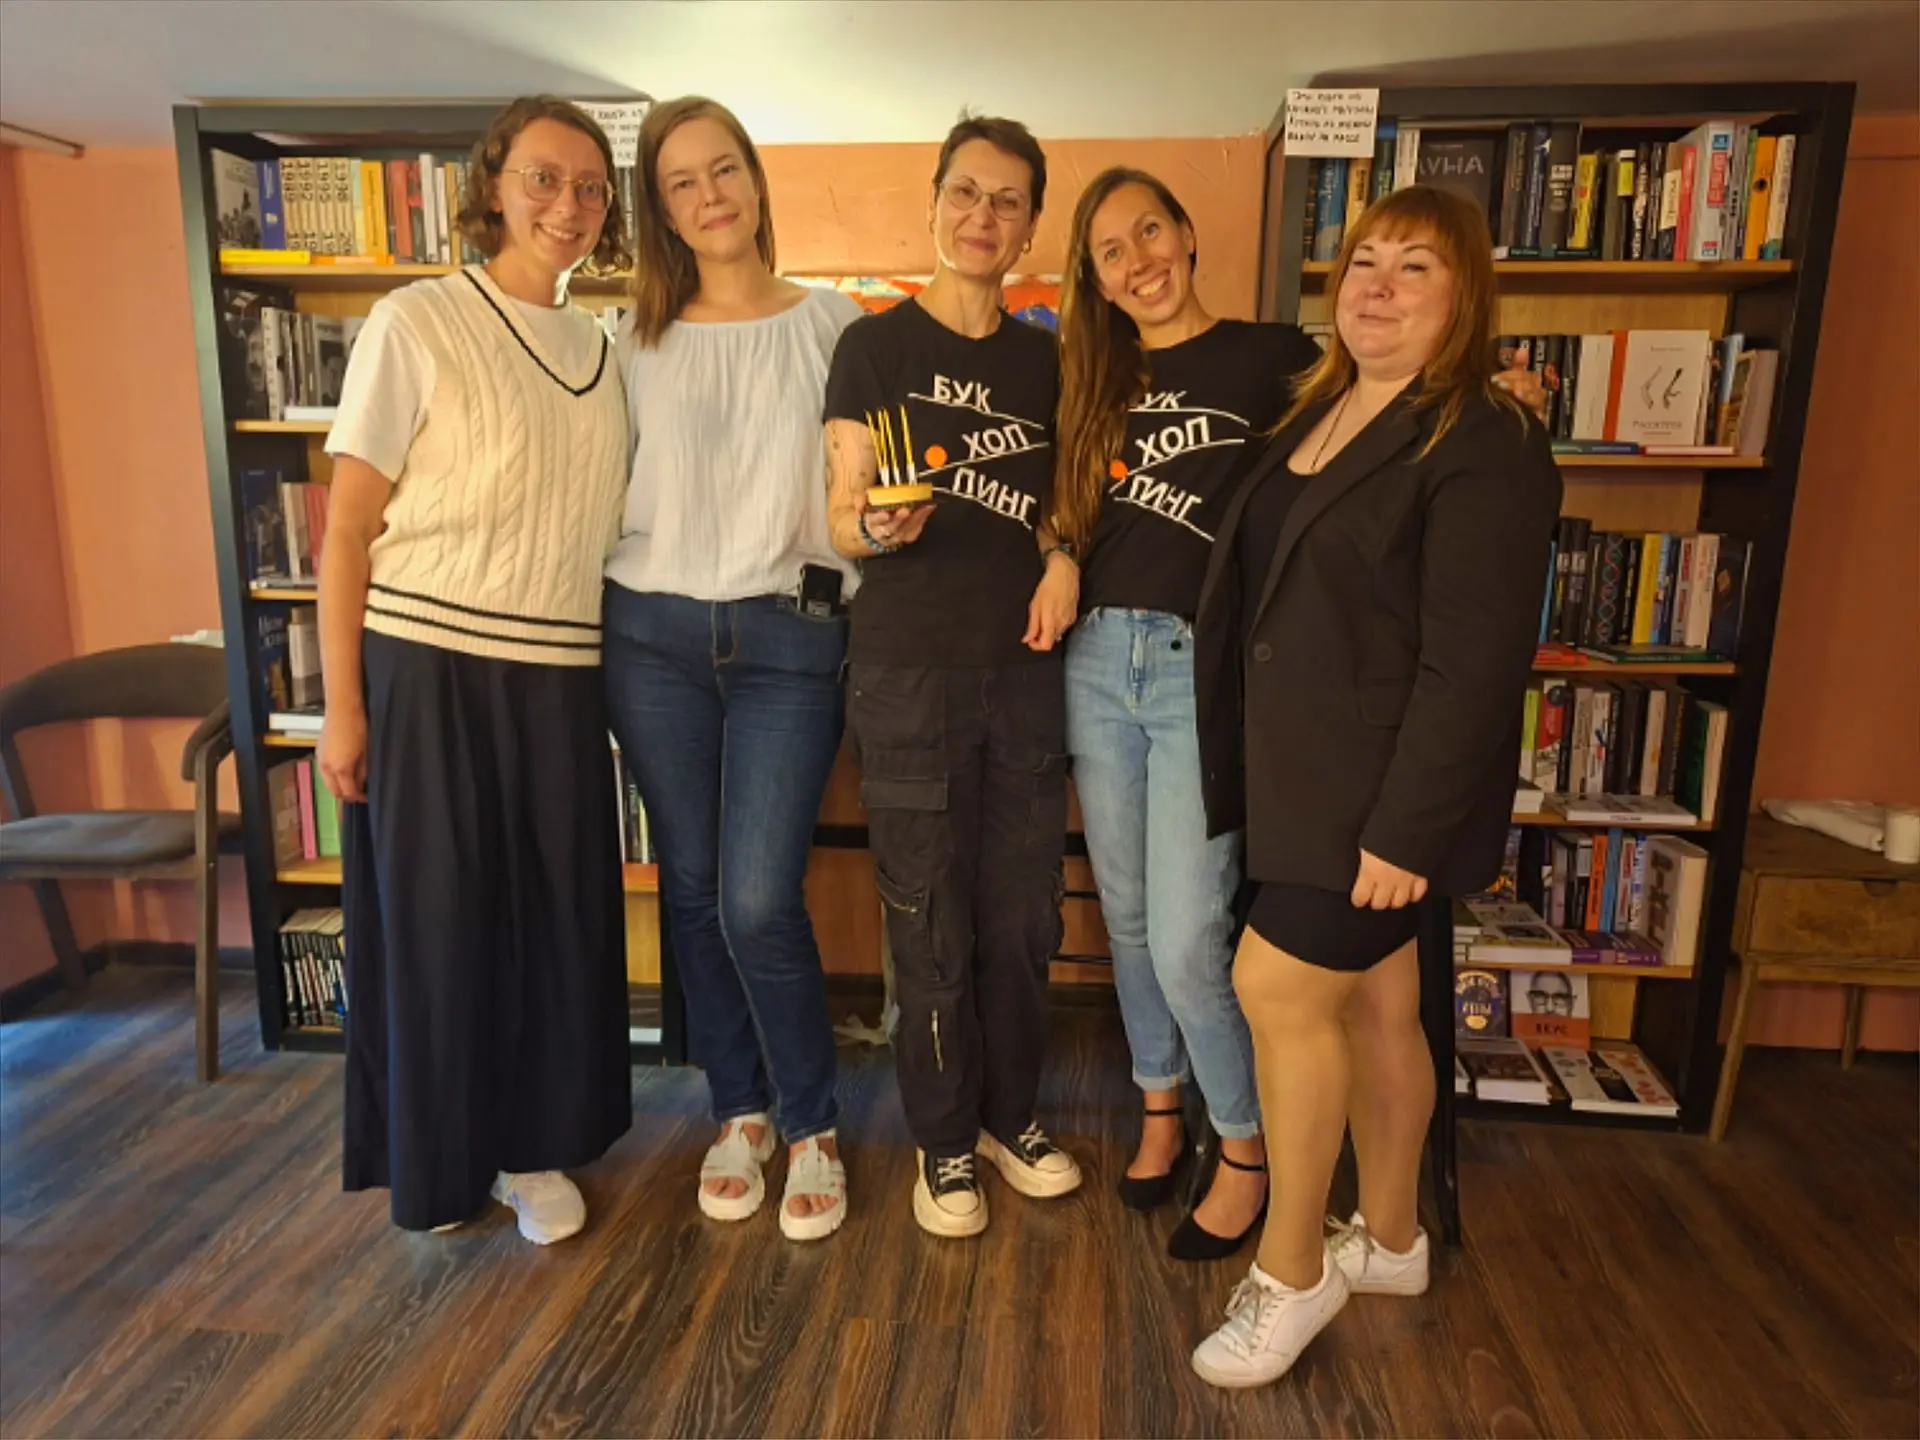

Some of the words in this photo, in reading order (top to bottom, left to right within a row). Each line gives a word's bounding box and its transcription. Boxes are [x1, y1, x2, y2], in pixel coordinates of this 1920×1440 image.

[933, 373, 991, 412] БУК
[1141, 390, 1188, 409] УК
[962, 423, 1029, 460] ХОП
[1136, 416, 1210, 466] ХОП
[952, 467, 1036, 522] ПИНГ
[1129, 475, 1202, 521] ПИНГ
